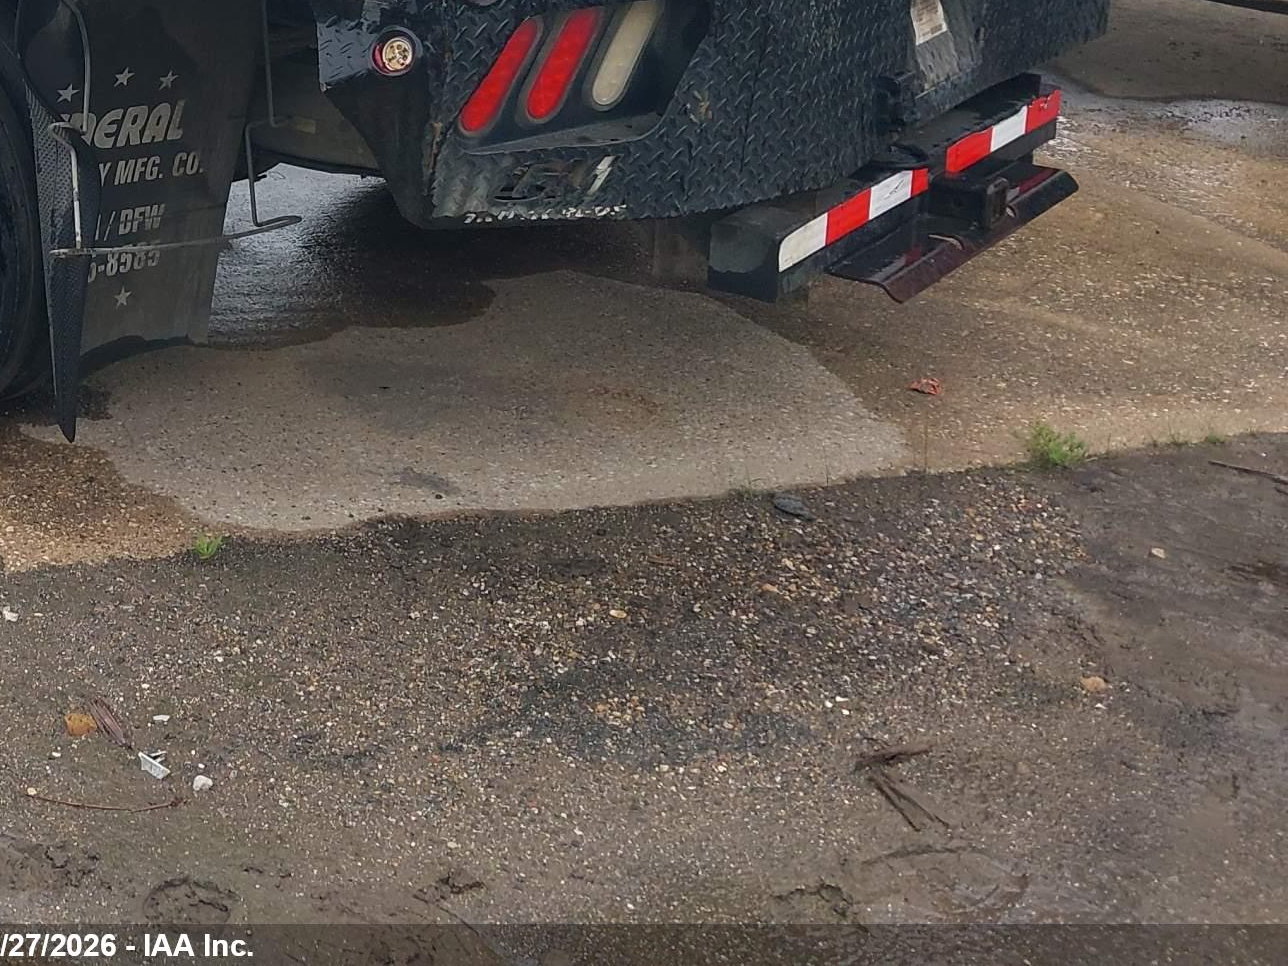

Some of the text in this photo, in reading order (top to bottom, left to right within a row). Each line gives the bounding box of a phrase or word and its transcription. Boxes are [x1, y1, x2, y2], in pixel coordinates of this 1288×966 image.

[114, 155, 163, 186] MFG.
[172, 151, 204, 177] CO.
[118, 203, 166, 235] DFW
